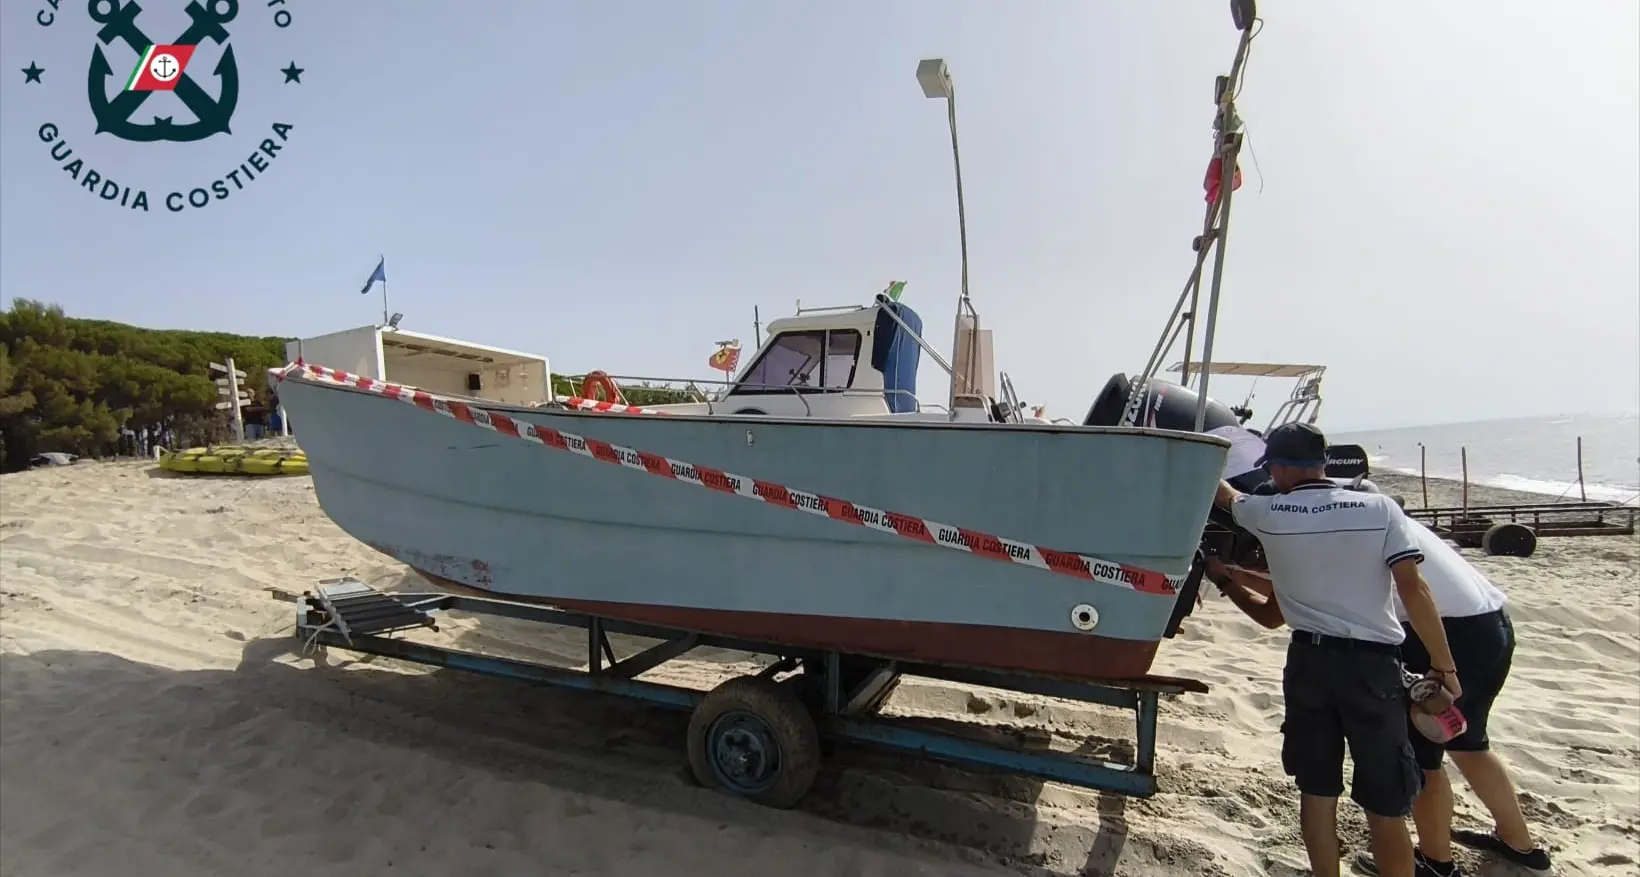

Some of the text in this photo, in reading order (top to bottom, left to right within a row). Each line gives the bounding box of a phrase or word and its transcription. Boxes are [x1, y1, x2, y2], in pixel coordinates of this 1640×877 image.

[671, 463, 741, 490] GUARDIA COSTIERA
[752, 483, 829, 512] GUARDIA COSTIERA
[1312, 501, 1366, 514] COSTIERA
[841, 505, 925, 535] GUARDIA COSTIERA
[938, 528, 1030, 560] GUARDIA COSTIERA
[1046, 553, 1145, 586] GUARDIA COSTIERA
